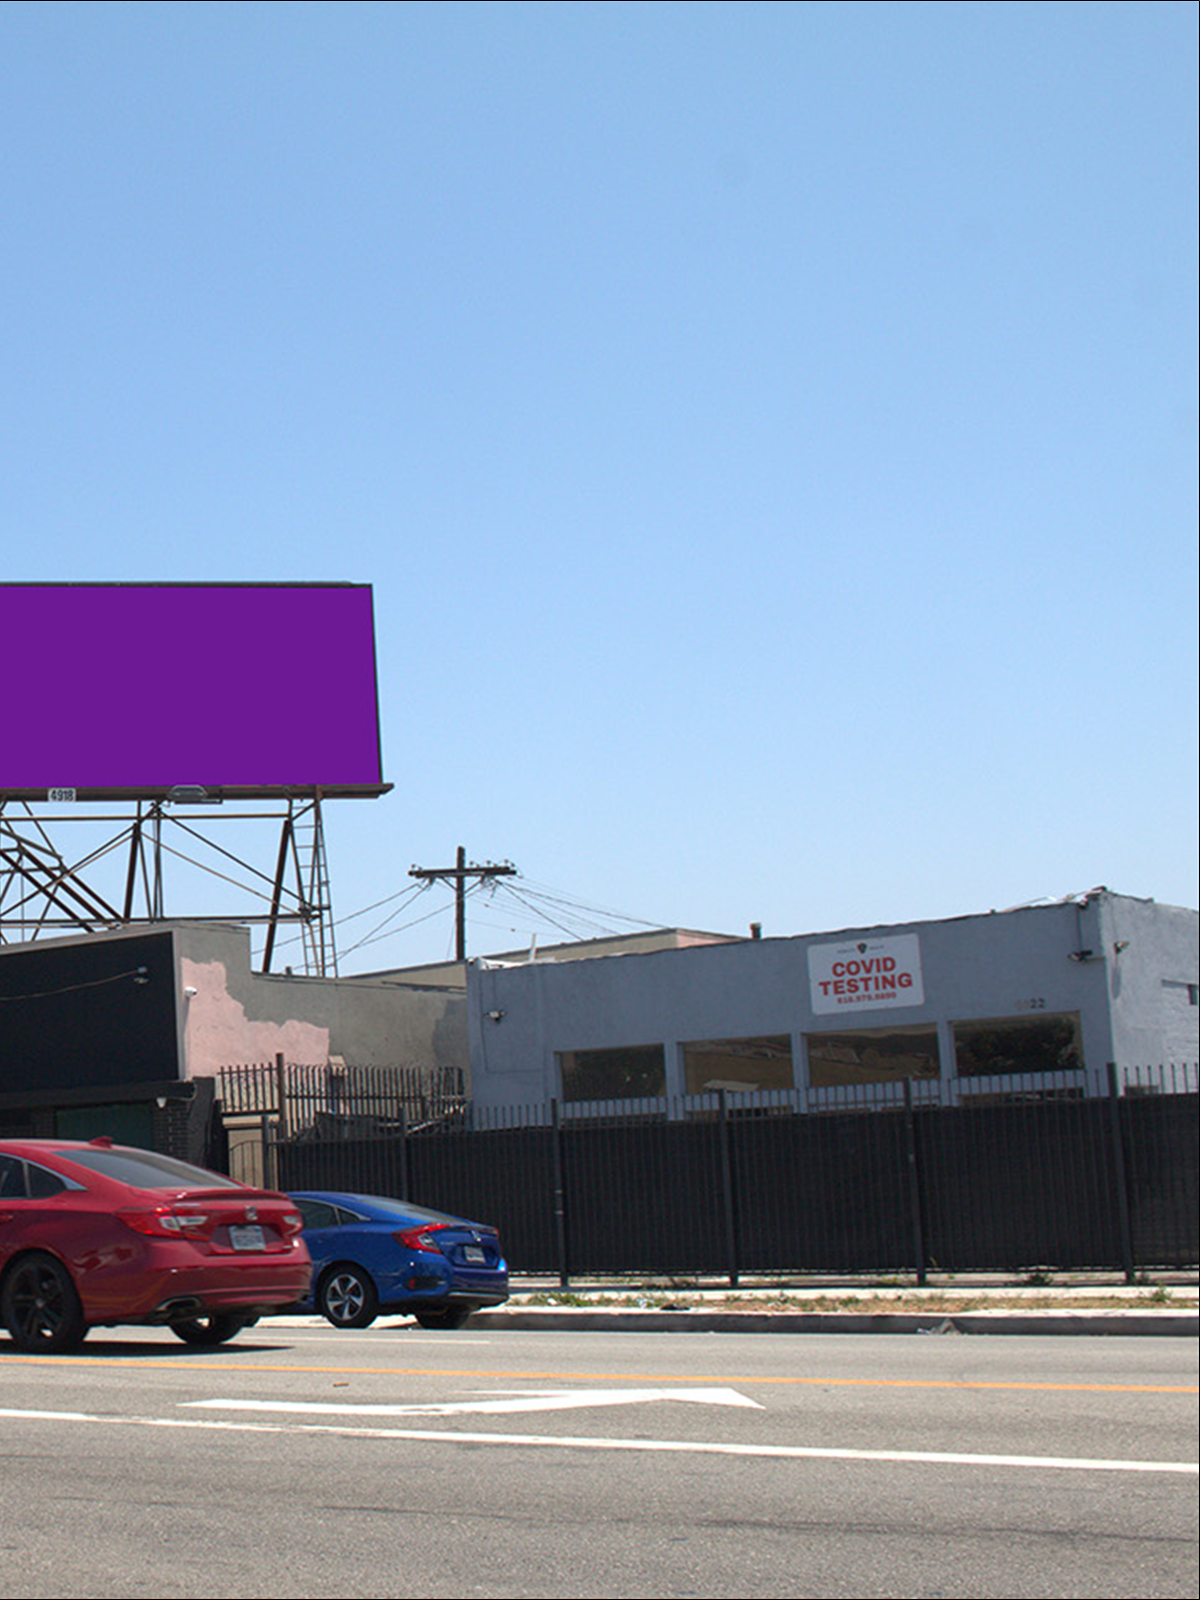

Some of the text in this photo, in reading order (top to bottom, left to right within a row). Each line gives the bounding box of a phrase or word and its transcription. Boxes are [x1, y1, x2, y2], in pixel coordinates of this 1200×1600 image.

[50, 789, 74, 801] 4918
[832, 957, 896, 977] COVID
[818, 973, 913, 996] TESTING
